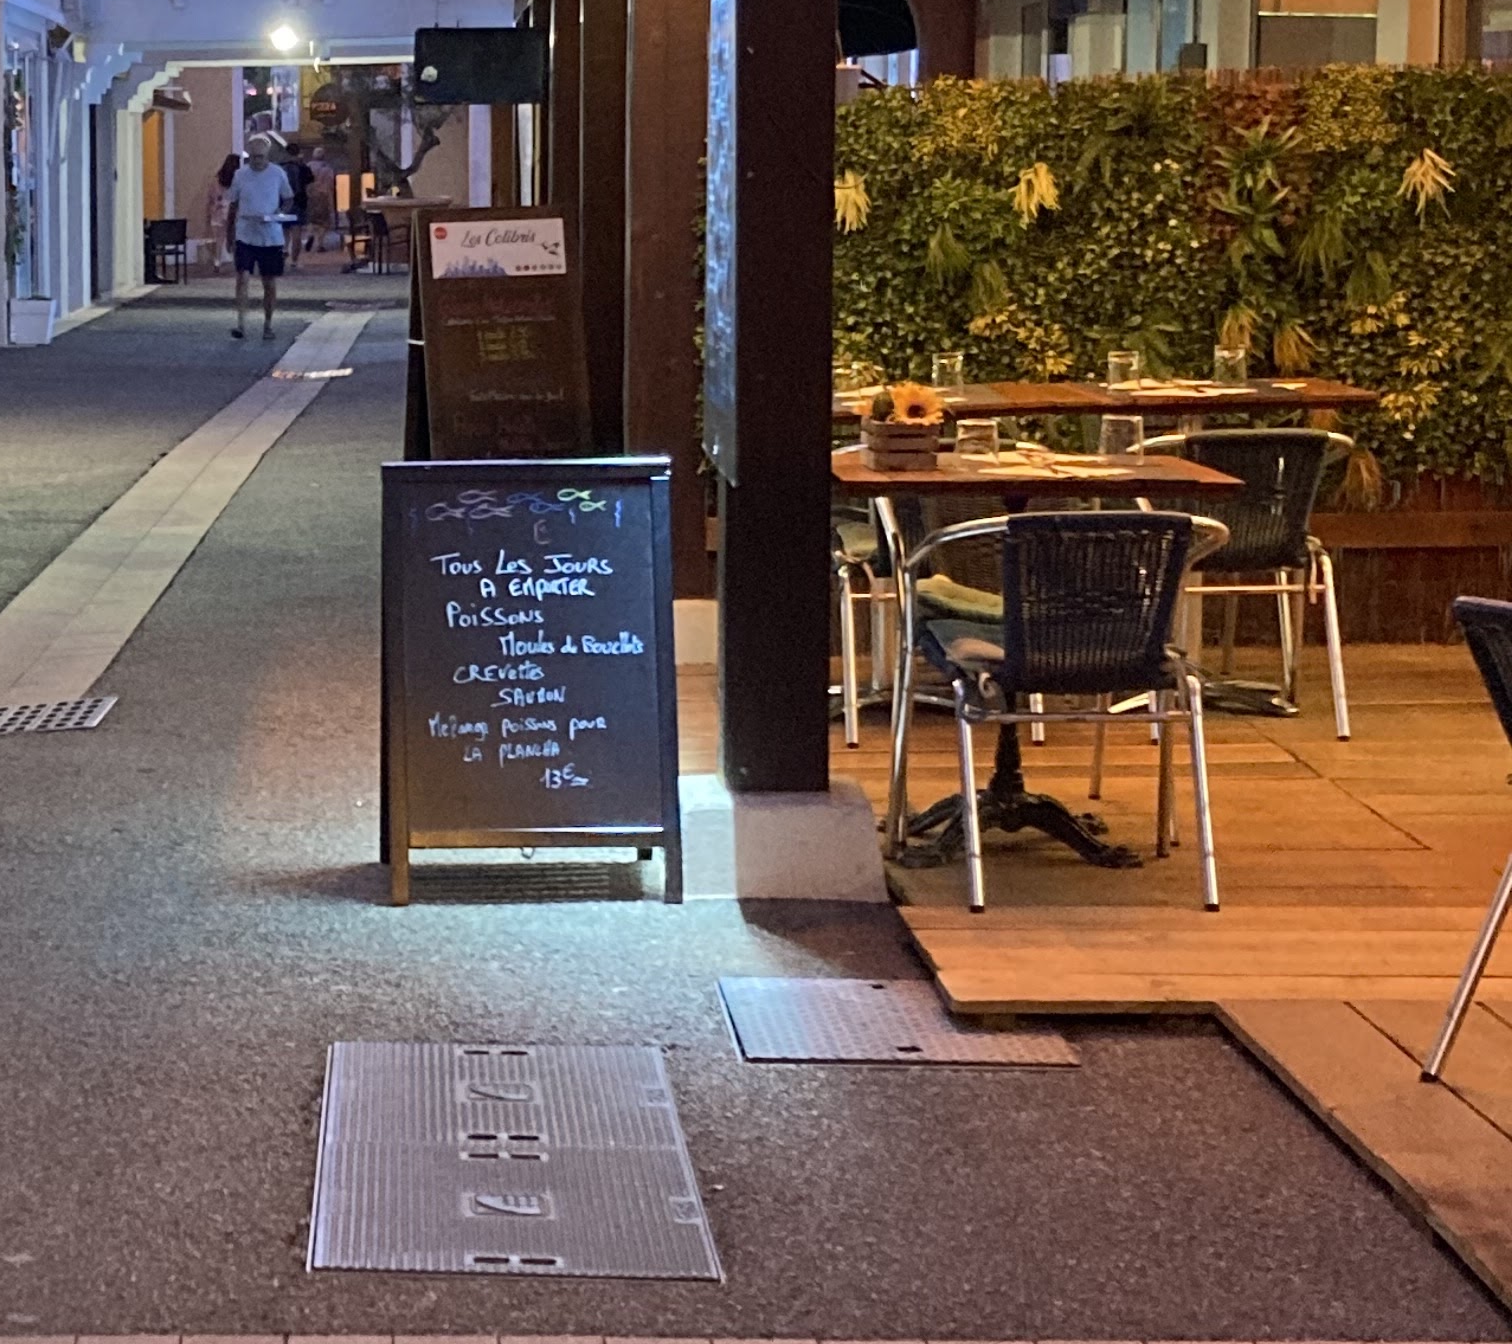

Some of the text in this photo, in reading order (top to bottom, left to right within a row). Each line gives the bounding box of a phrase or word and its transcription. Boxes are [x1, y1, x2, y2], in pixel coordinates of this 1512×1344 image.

[460, 230, 481, 248] Les
[495, 549, 533, 575] Les
[479, 578, 496, 598] A
